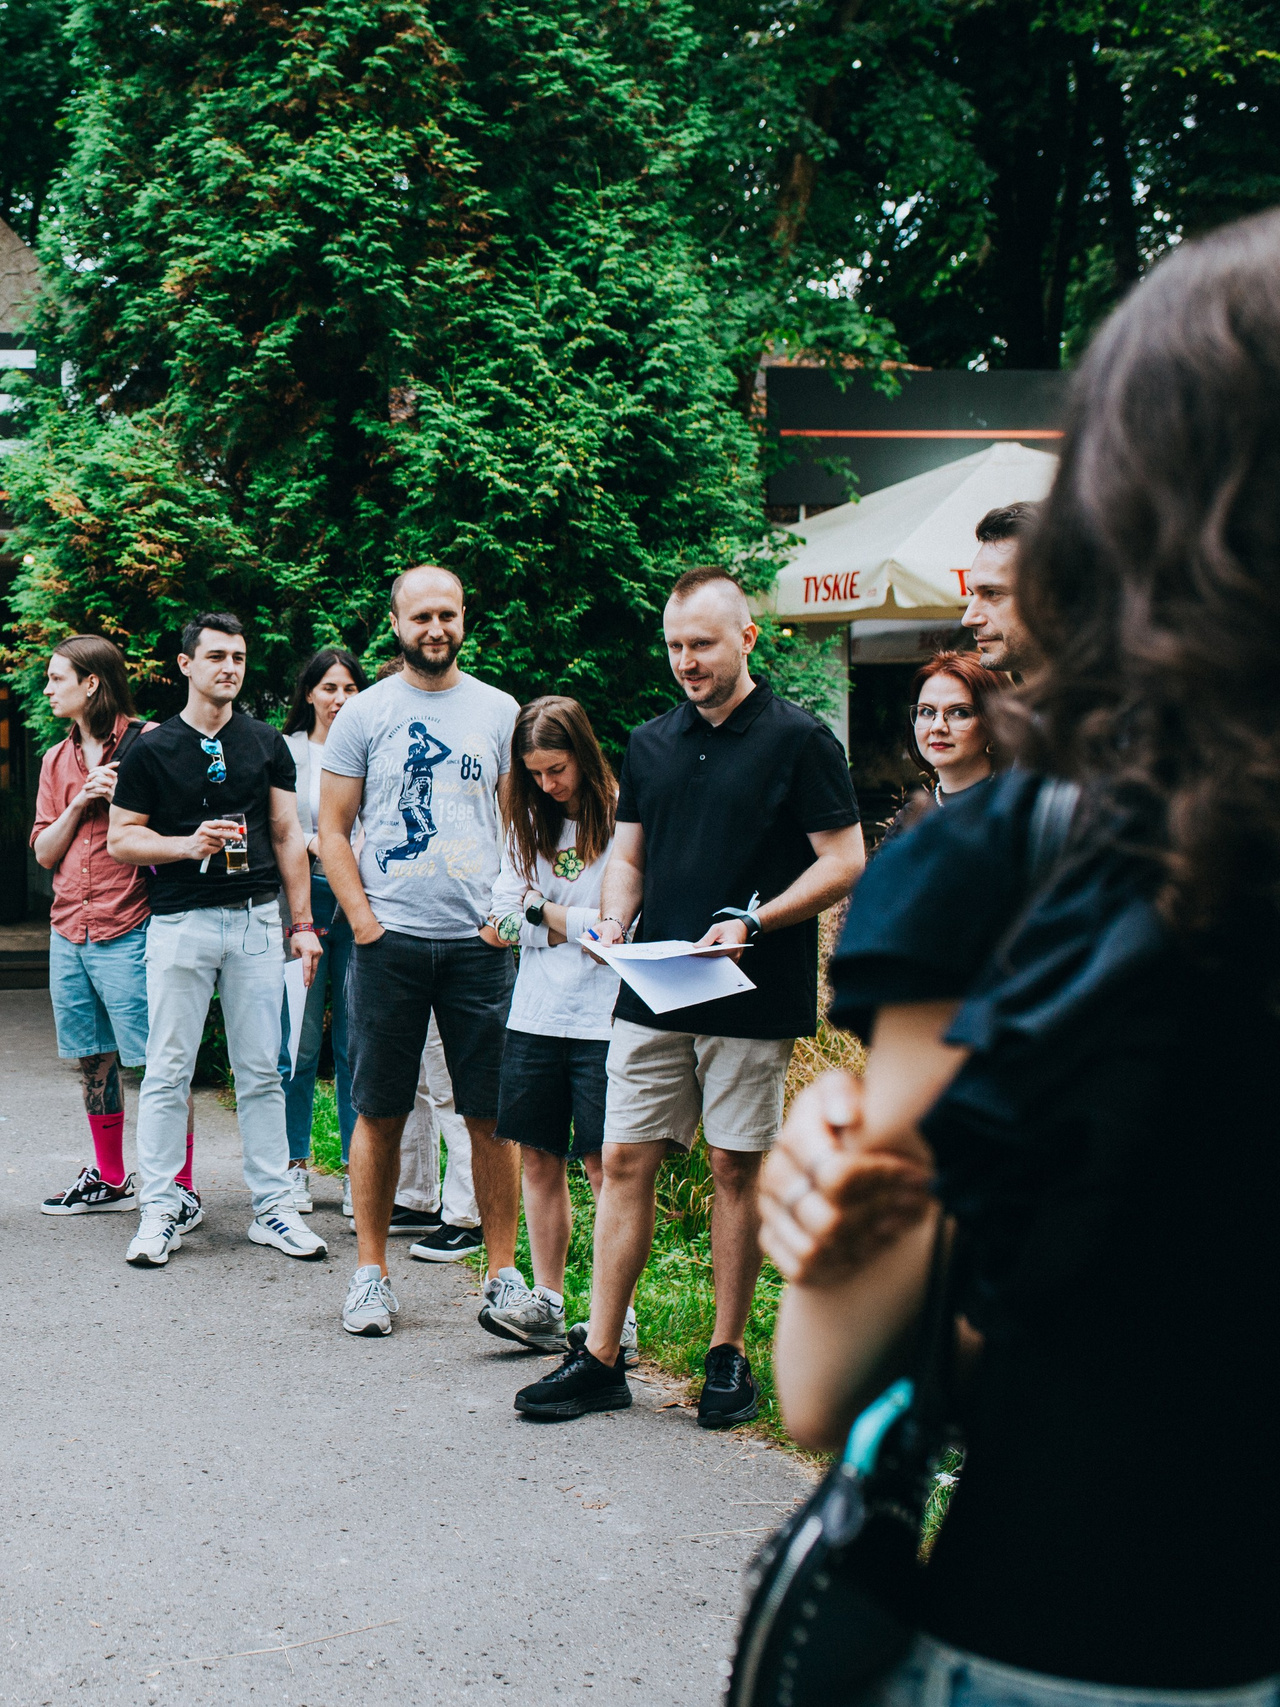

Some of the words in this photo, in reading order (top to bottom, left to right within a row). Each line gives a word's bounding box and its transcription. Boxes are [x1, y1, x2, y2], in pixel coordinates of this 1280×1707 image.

[803, 571, 860, 603] TYSKIE
[373, 755, 404, 784] Pla
[460, 753, 482, 781] 85
[437, 798, 475, 823] 1985
